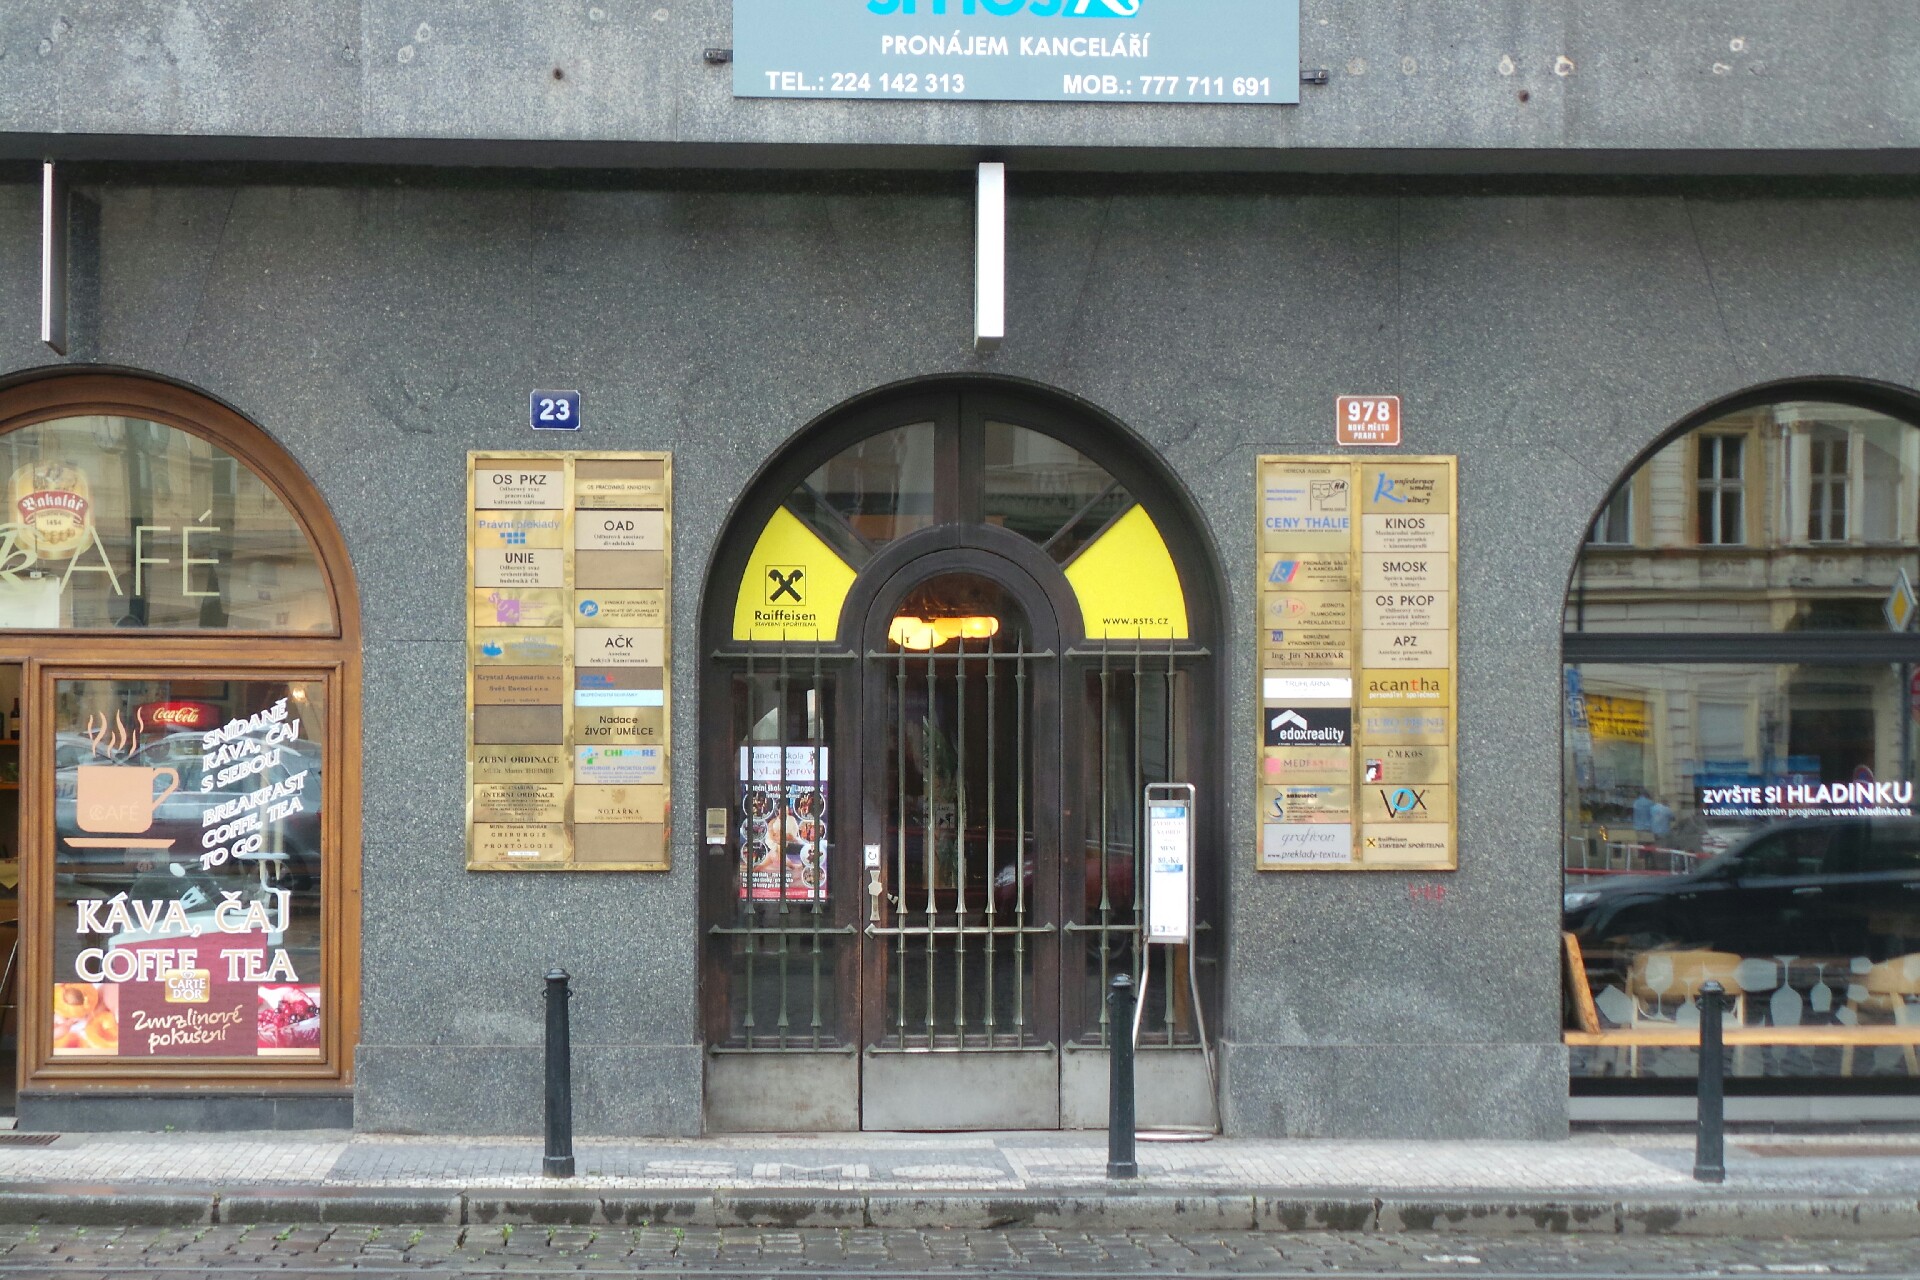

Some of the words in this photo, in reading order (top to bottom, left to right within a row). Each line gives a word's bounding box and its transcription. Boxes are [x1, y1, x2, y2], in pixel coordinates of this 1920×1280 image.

[881, 30, 1008, 56] PRONÁJEM
[1020, 32, 1150, 58] KANCELÁŘÍ
[765, 71, 824, 91] TEL.:
[831, 72, 871, 92] 224
[879, 73, 918, 93] 142
[925, 73, 965, 93] 313
[1063, 74, 1132, 95] MOB.:
[1140, 76, 1179, 95] 777
[1186, 76, 1223, 96] 711
[1232, 77, 1270, 96] 691
[540, 398, 570, 421] 23
[1348, 401, 1390, 422] 978
[1347, 422, 1365, 431] NOVÉ
[1367, 422, 1389, 431] MĚSTO
[1354, 432, 1376, 440] PRAHA
[492, 474, 513, 485] OS
[520, 474, 547, 485] PKZ
[604, 520, 635, 531] OAD
[1266, 517, 1299, 528] CENY
[1304, 515, 1349, 528] THÁLIE
[1385, 518, 1426, 529] KINOS
[505, 552, 535, 563] UNIE
[1382, 561, 1427, 572] SMOSK
[1376, 595, 1394, 606] OS
[1400, 595, 1435, 606] PKOP
[755, 610, 816, 620] Raiffeisen
[604, 634, 633, 648] AČK
[1393, 636, 1418, 646] APZ
[1369, 678, 1440, 692] acantha
[202, 697, 288, 750] SNÍDANĚ
[600, 715, 638, 724] Nadace
[1280, 727, 1344, 742] edoxreality
[202, 740, 261, 772] KÁVA,
[266, 718, 300, 746] ČAJ
[510, 756, 560, 764] ORDINACE
[200, 775, 214, 794] S
[216, 748, 280, 789] SEBOU
[202, 770, 308, 827] BREAKFAST
[1703, 785, 1760, 803] ZVYŠTE
[1764, 786, 1782, 803] SI
[1787, 781, 1914, 804] HLADINKU
[266, 796, 303, 823] TEA
[1380, 788, 1427, 818] VOX
[1789, 809, 1830, 818] programu
[200, 849, 228, 871] TO
[231, 834, 262, 858] GO
[76, 891, 201, 938] KÁVA,
[215, 890, 291, 934] ČAJ
[220, 948, 298, 982] TEA
[168, 977, 206, 989] CARTE
[132, 1005, 243, 1031] Zmrzlinové
[148, 1024, 230, 1054] pokušení
